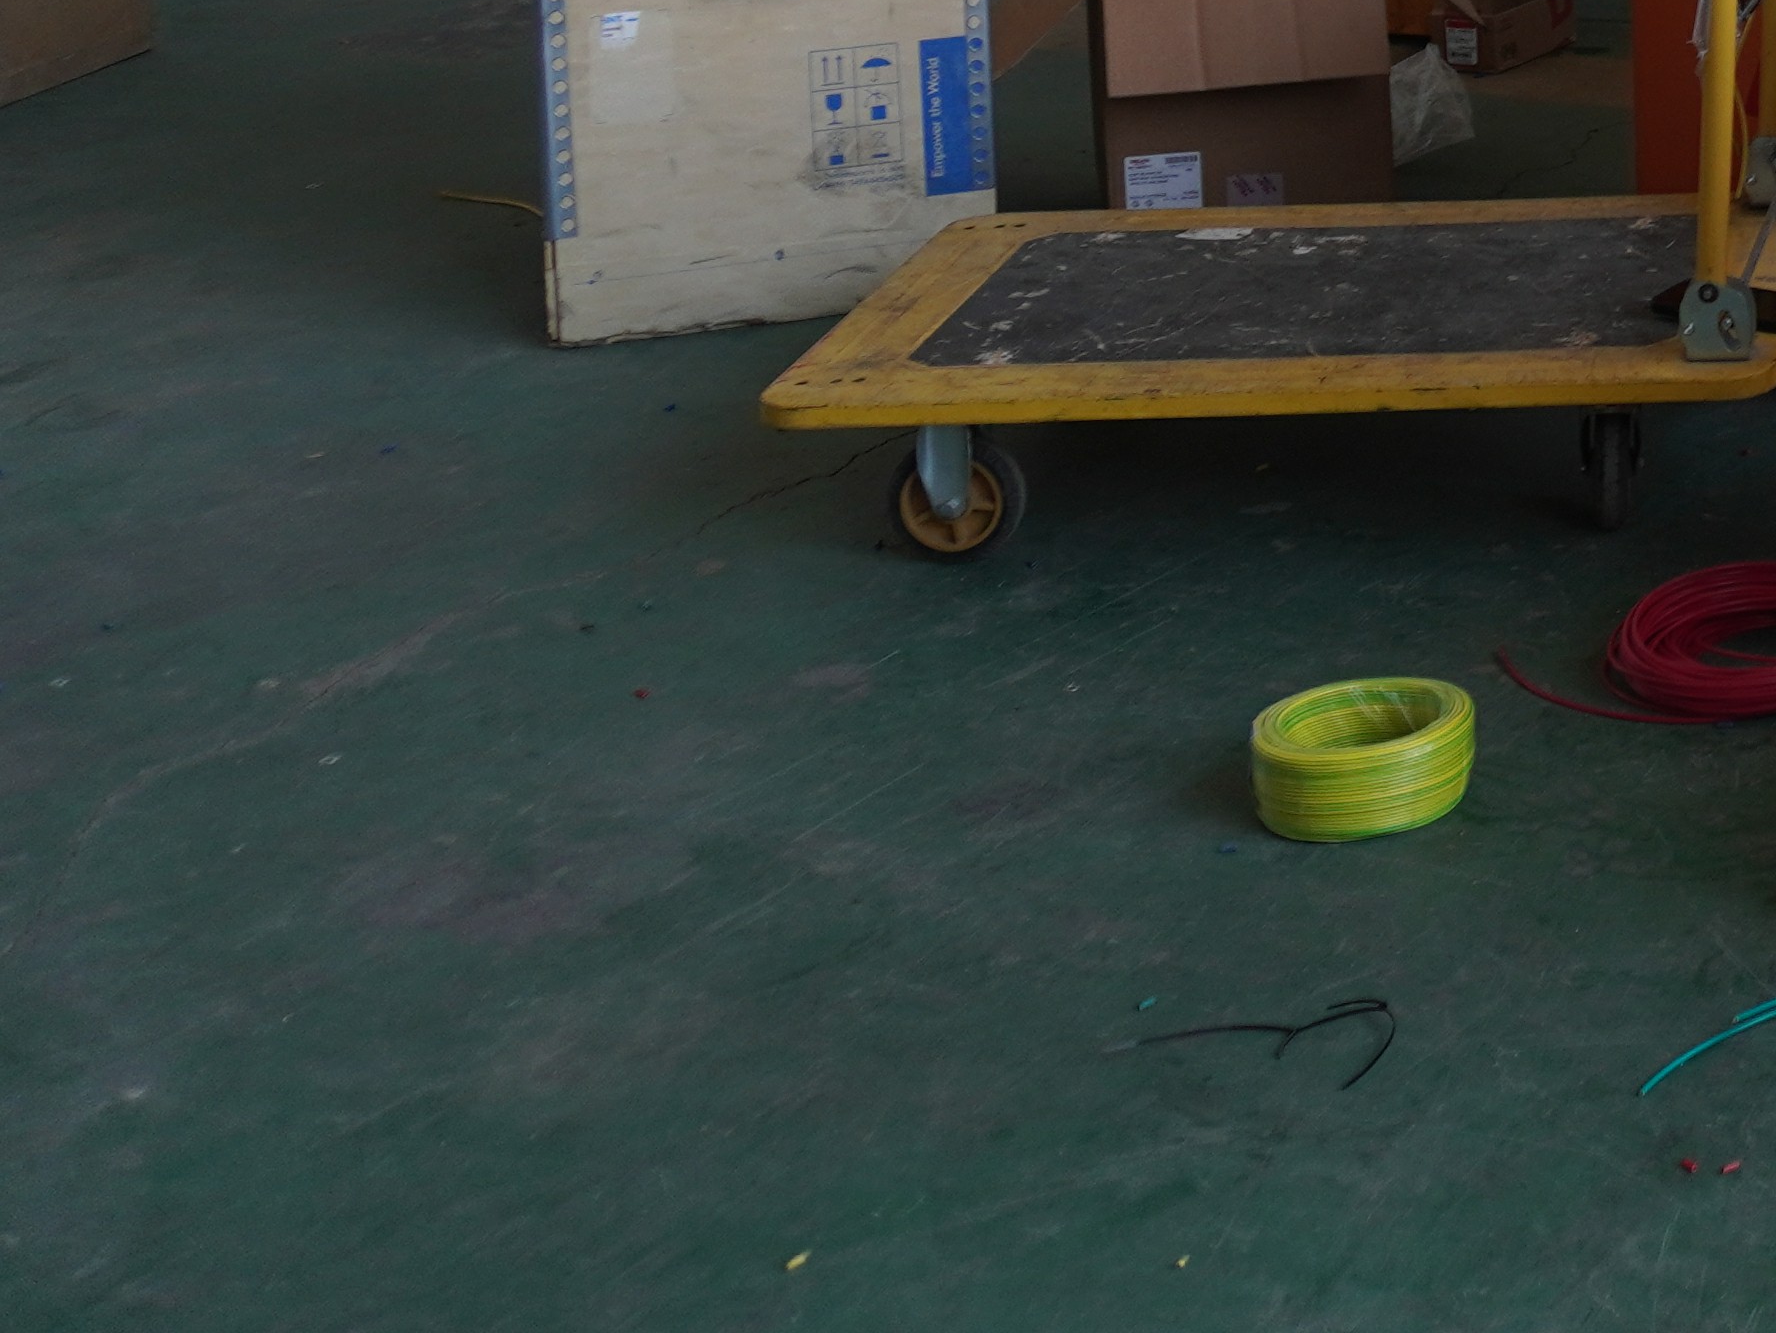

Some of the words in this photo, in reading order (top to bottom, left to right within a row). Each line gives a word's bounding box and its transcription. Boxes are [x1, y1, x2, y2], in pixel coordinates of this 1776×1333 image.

[926, 56, 942, 96] World
[928, 96, 943, 118] the
[931, 121, 947, 178] Empower
